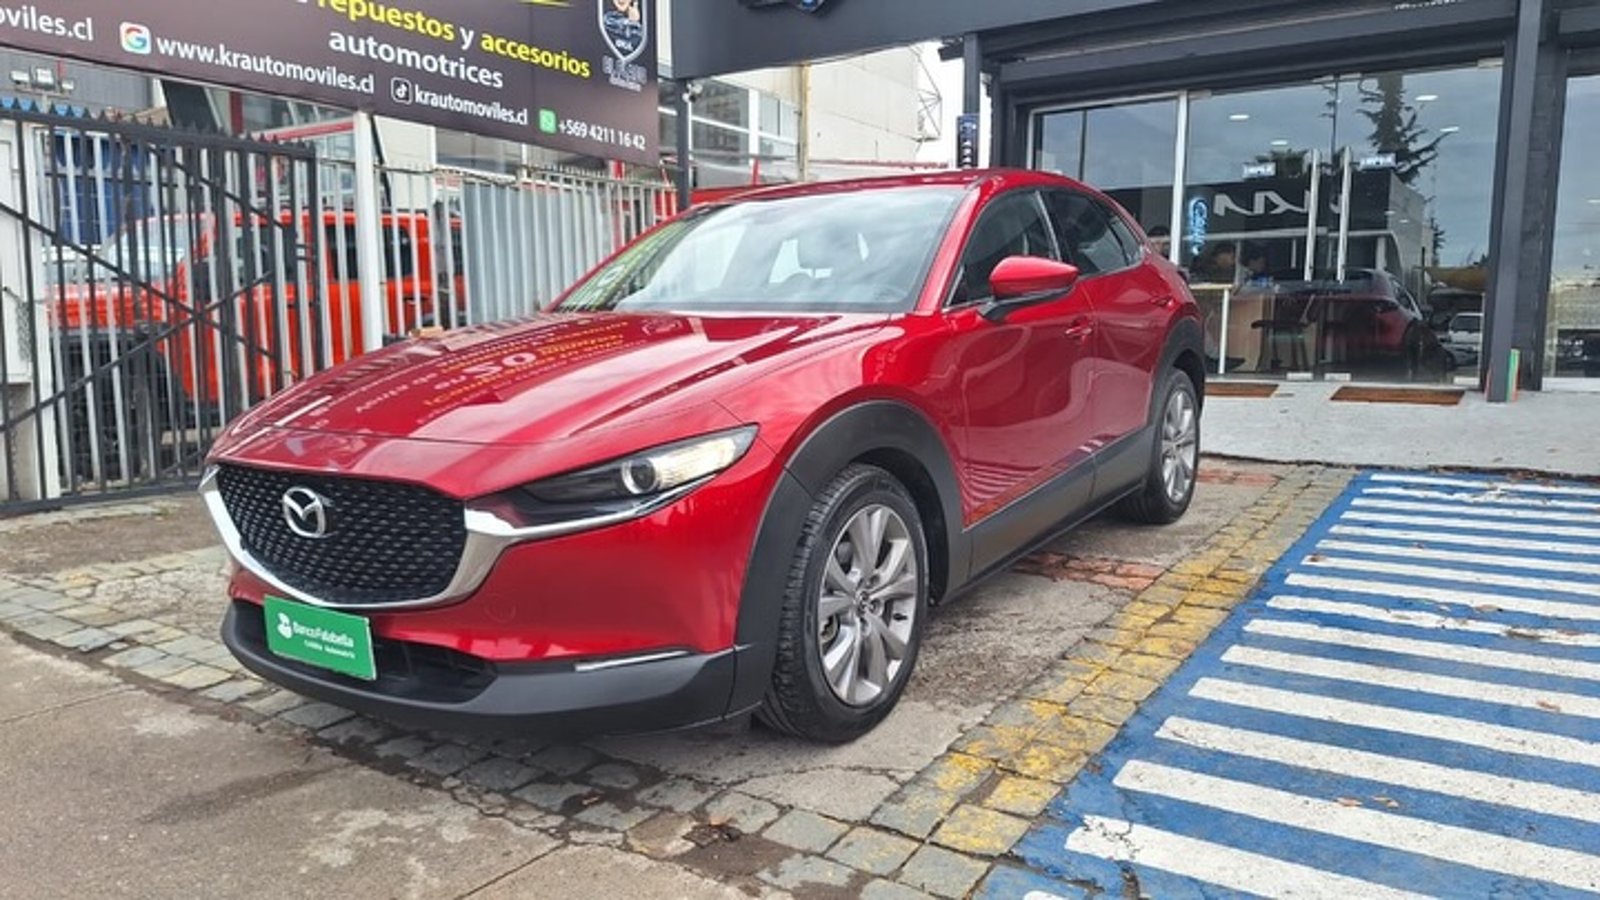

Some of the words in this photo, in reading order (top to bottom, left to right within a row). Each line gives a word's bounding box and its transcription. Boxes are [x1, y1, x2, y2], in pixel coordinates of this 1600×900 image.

[156, 36, 374, 95] www.krautomoviles.cl
[328, 30, 504, 88] automotrices
[459, 26, 475, 51] y
[480, 33, 591, 78] accesorios
[414, 83, 528, 125] krautomoviles.cl
[558, 119, 587, 138] +569
[589, 125, 615, 144] 4211
[618, 130, 632, 147] 16
[632, 134, 646, 151] 42
